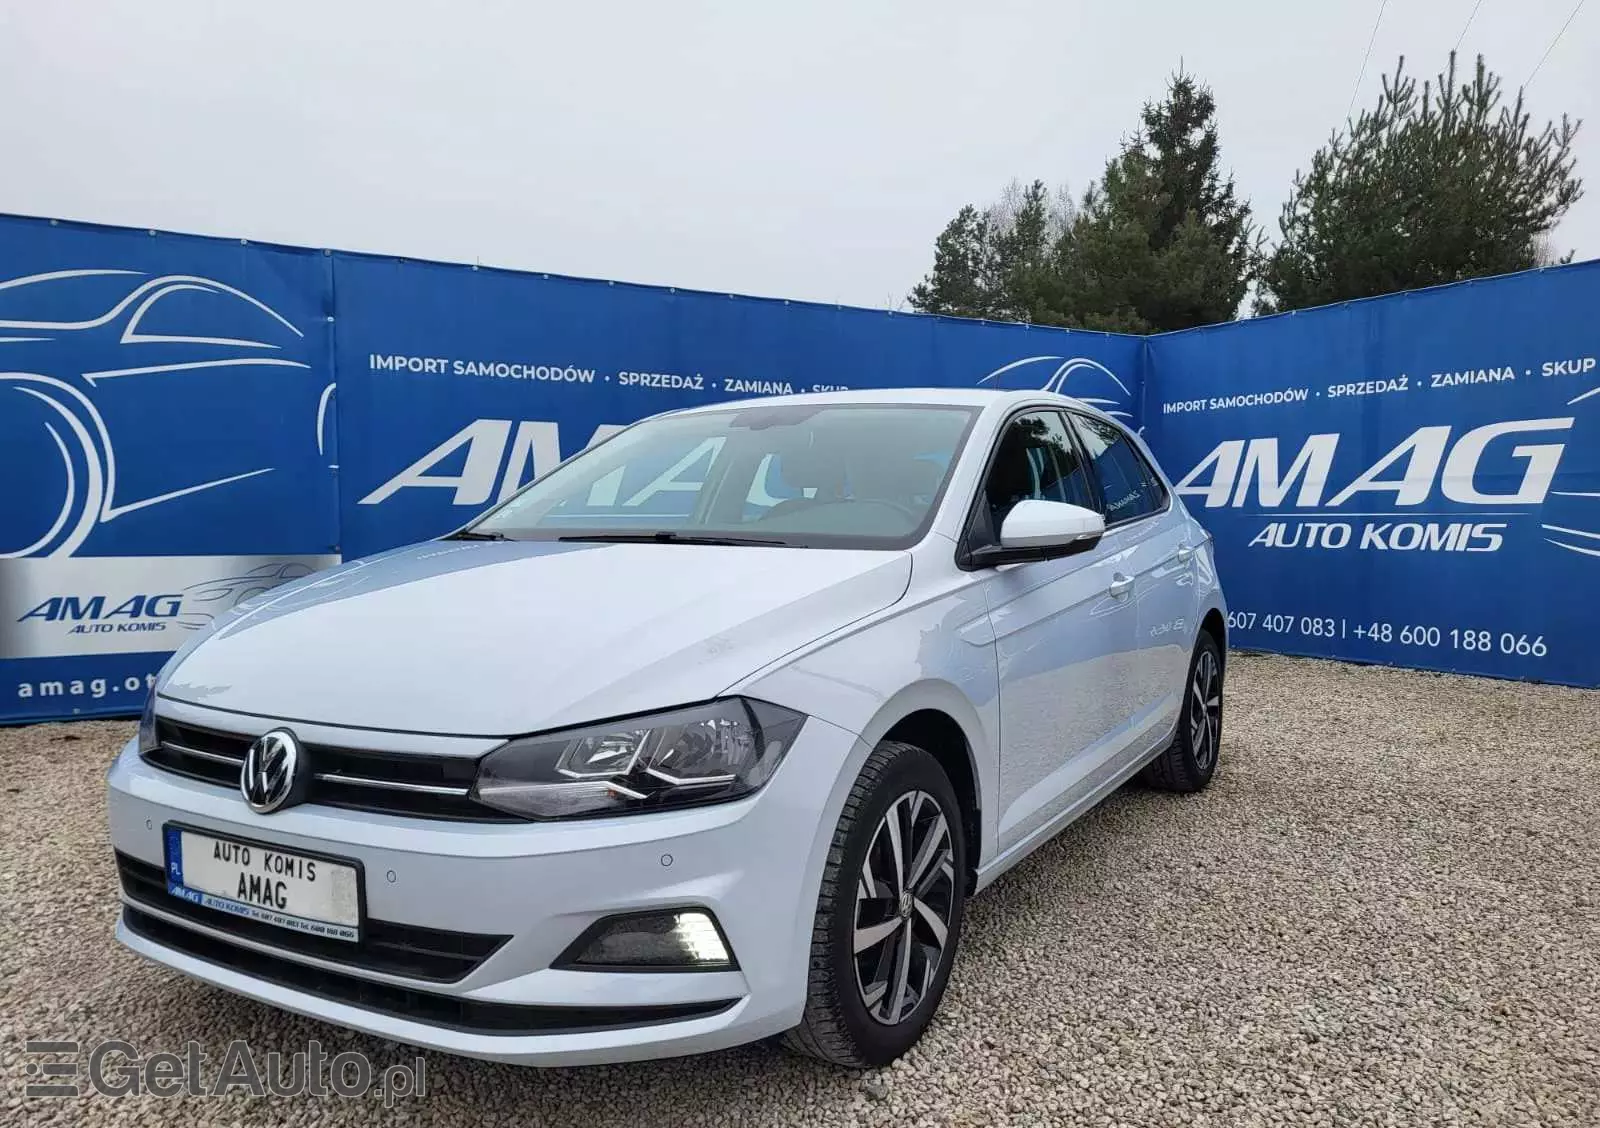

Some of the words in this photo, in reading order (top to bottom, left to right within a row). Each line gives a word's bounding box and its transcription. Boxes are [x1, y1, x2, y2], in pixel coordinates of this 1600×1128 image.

[369, 353, 449, 374] IMPORT
[453, 360, 596, 384] SAMOCHODÓW
[618, 371, 705, 391] SPRZEDAŻ
[724, 378, 794, 395] ZAMIANA
[1163, 398, 1208, 415] IMPORT
[1209, 387, 1309, 410] SAMOCHODÓW
[1327, 375, 1409, 399] SPRZEDAŻ
[1430, 366, 1515, 389] ZAMIANA
[1541, 357, 1597, 378] SKUP
[1247, 522, 1352, 549] AUTO
[1360, 522, 1508, 552] KOMIS
[67, 622, 113, 635] AUTO
[116, 621, 167, 633] KOMIS
[1228, 611, 1256, 630] 607
[1262, 613, 1294, 633] 407
[1300, 616, 1336, 638] 083
[1353, 621, 1394, 643] +48
[1400, 625, 1441, 648] 600
[1450, 629, 1492, 652] 188
[1499, 633, 1547, 658] 066
[170, 862, 182, 875] PL
[213, 840, 251, 867] AUTO
[263, 853, 317, 883] KOMIS
[236, 872, 289, 910] AMAG
